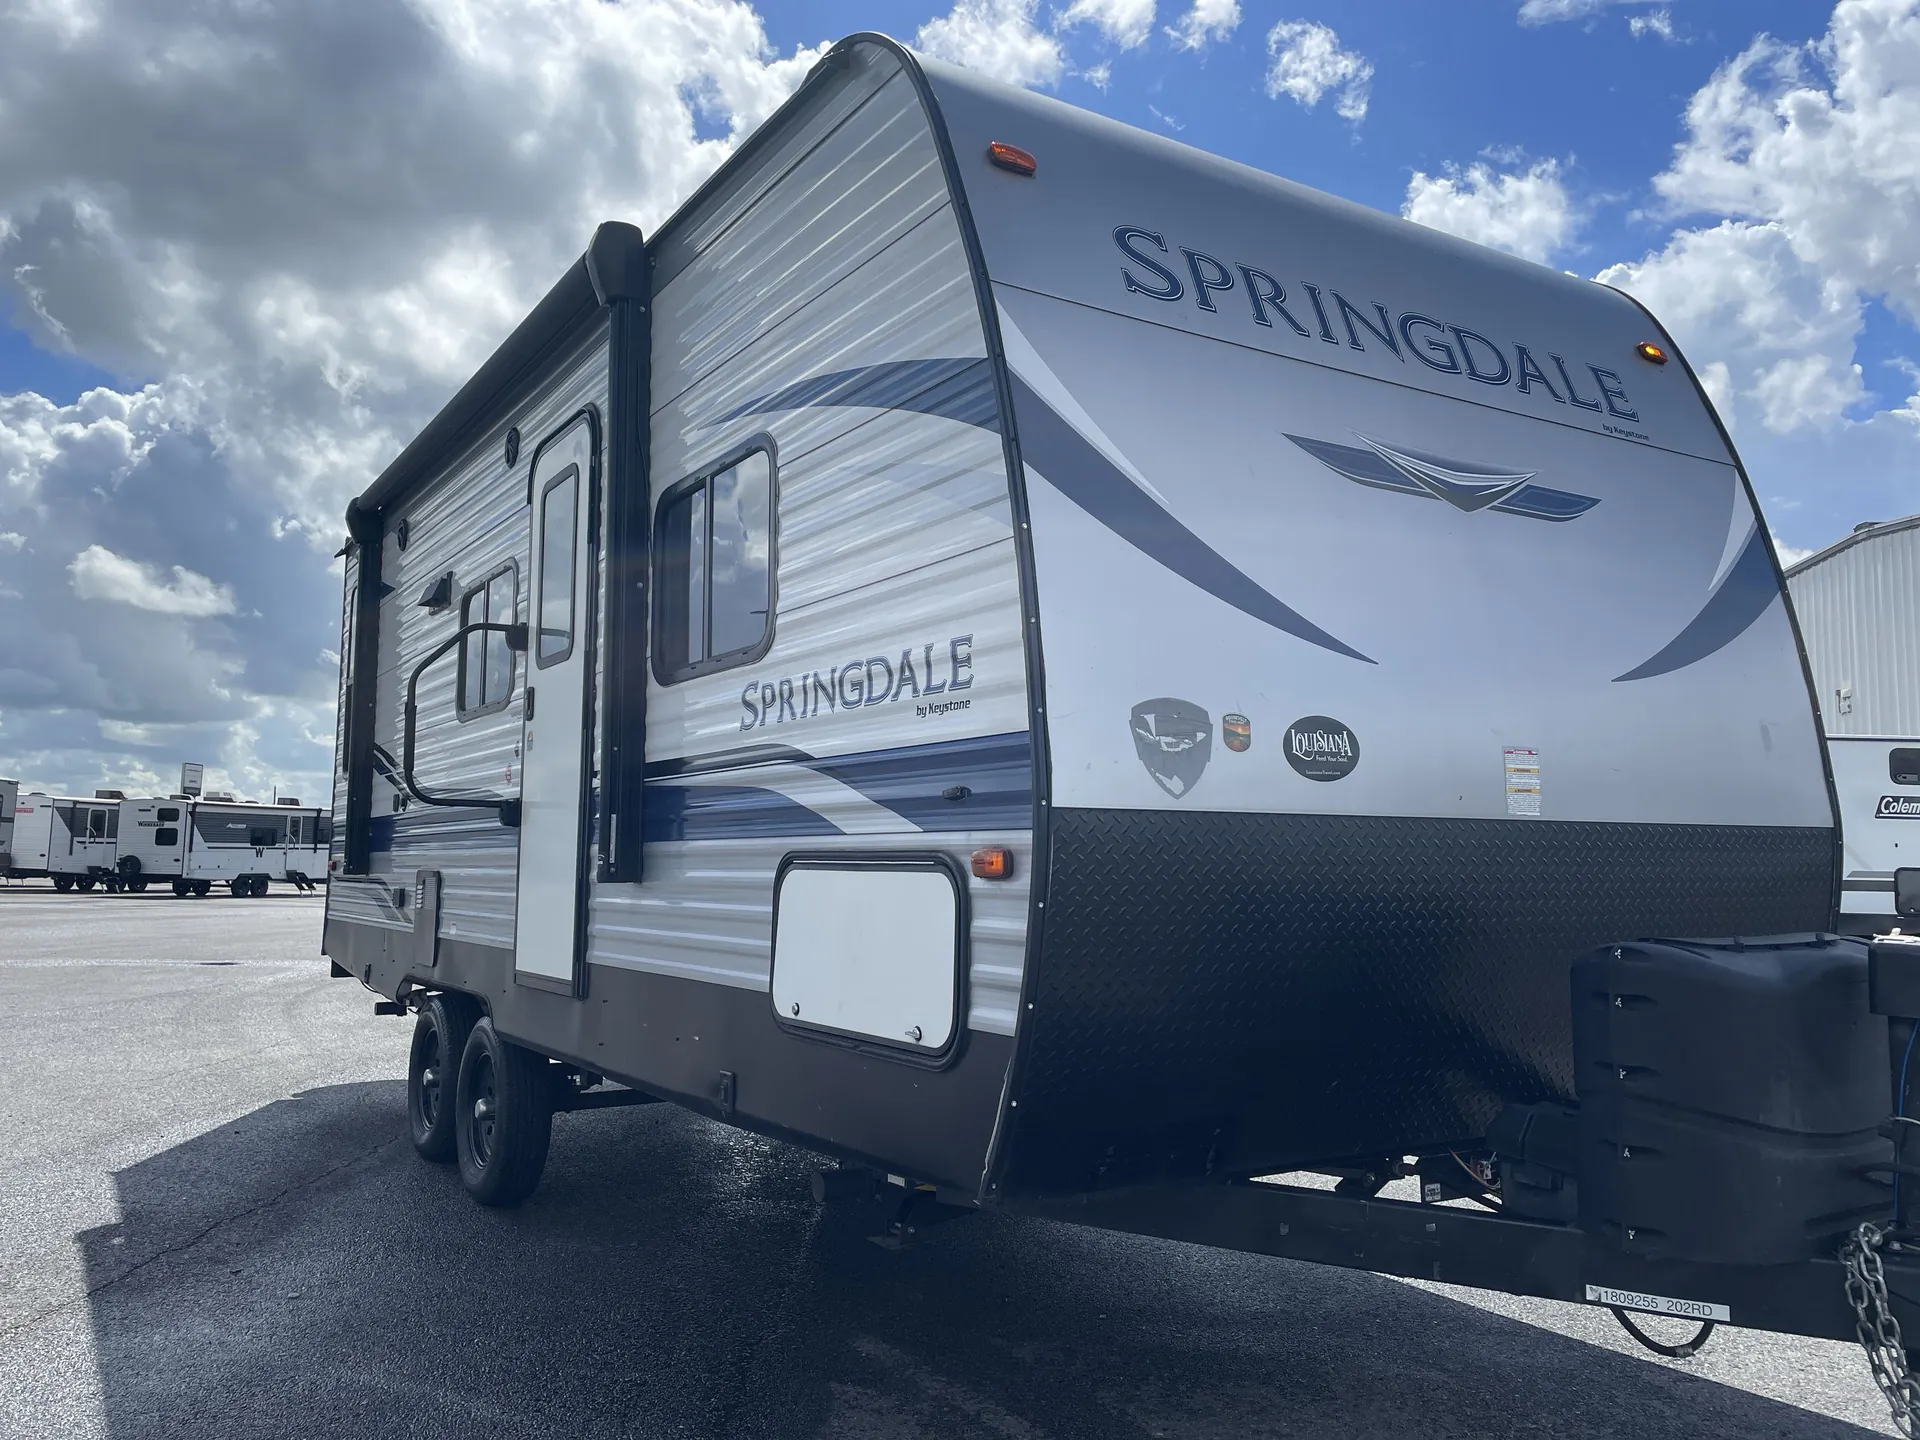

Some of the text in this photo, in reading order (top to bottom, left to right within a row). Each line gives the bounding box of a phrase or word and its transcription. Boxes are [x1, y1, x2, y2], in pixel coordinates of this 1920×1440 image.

[1111, 223, 1640, 423] SPRINGDALE
[1602, 423, 1650, 441] by Keystone
[739, 633, 974, 731] SPRINGDALE
[916, 699, 971, 718] by Keystone
[1290, 728, 1353, 761] LOUISIANA
[1603, 1289, 1713, 1317] 1809255 202RD
